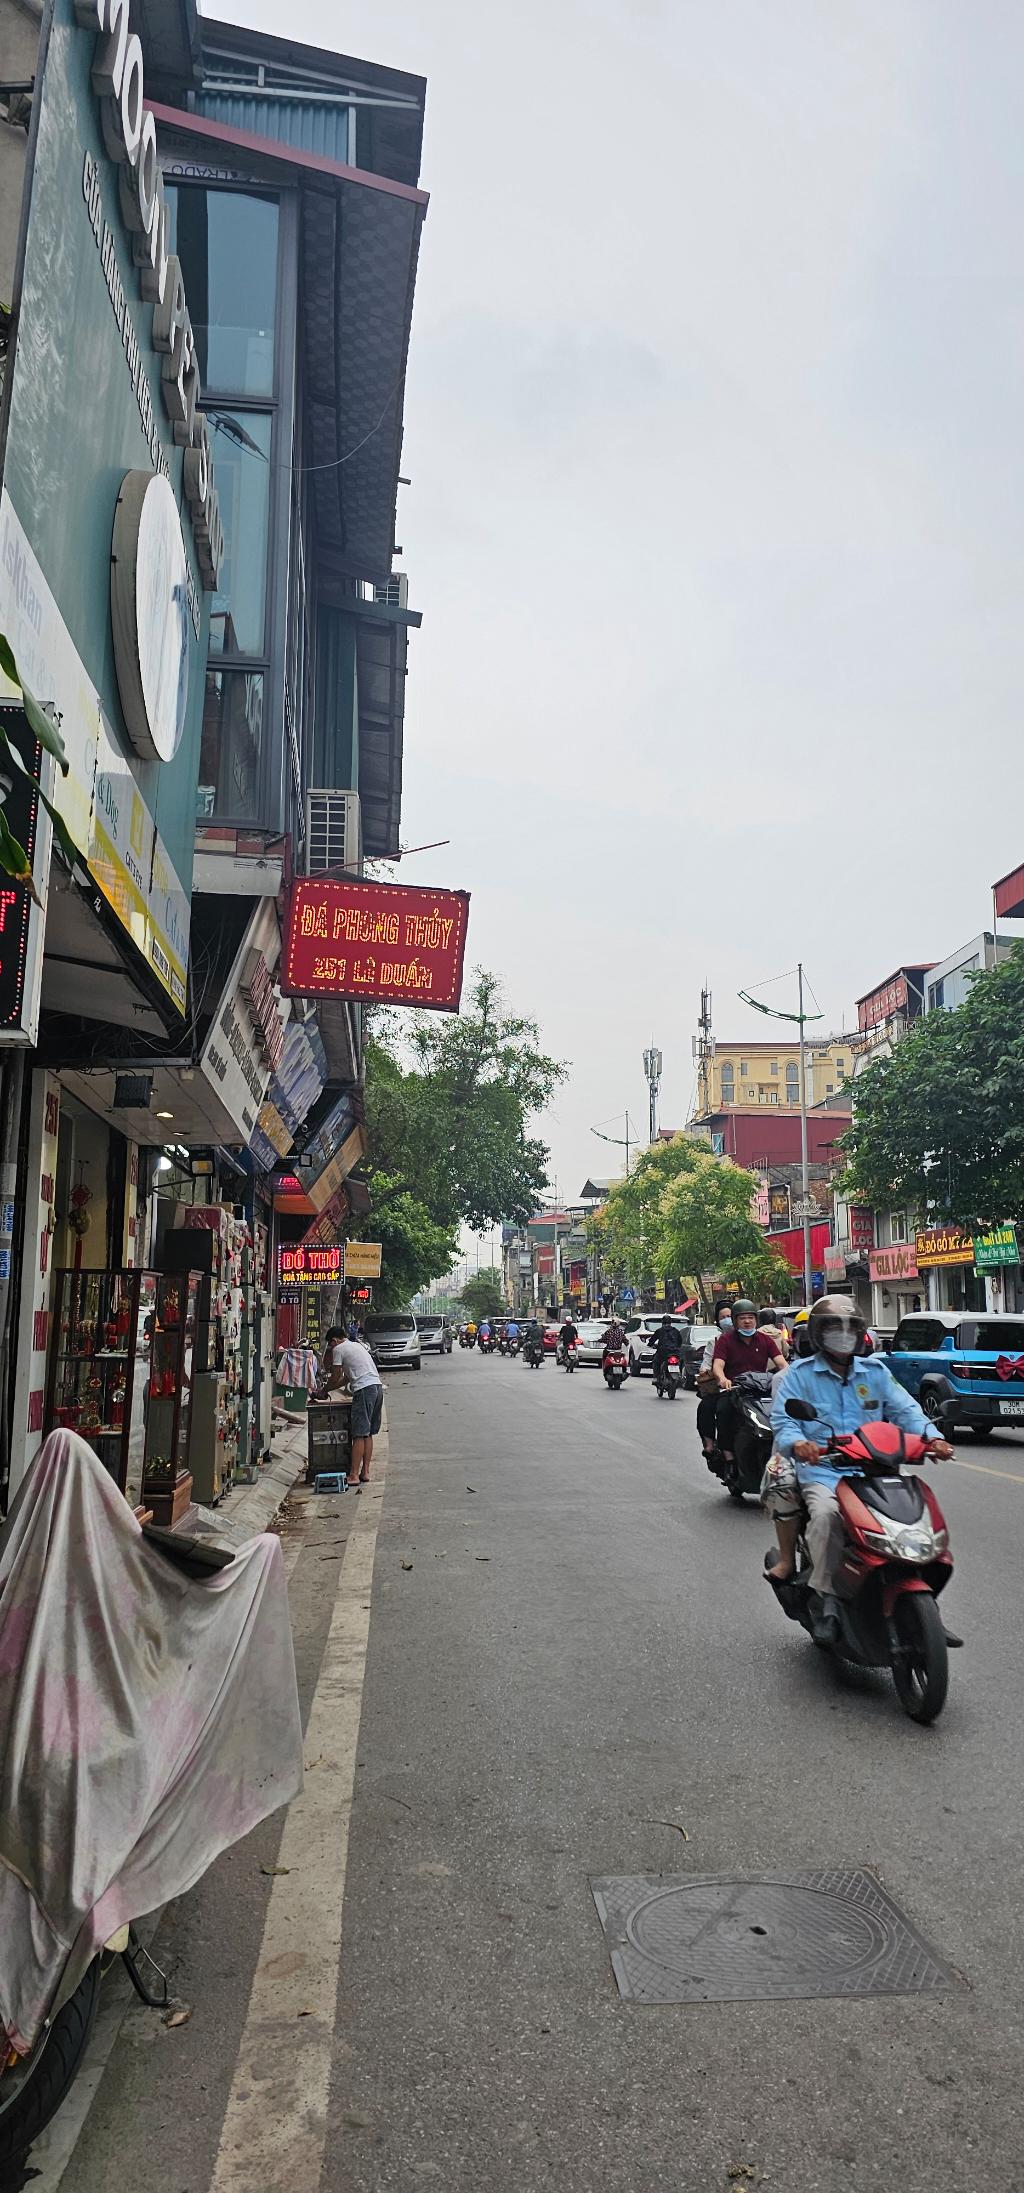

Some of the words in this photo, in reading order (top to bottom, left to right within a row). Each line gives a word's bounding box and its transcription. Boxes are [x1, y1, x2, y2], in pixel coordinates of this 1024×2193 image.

[101, 220, 125, 332] HÀNG
[122, 304, 140, 391] PHỤ
[105, 780, 119, 841] Dog
[301, 901, 328, 938] ĐÁ
[333, 908, 400, 944] PHONG
[405, 908, 453, 950] THỦY
[312, 957, 347, 981] 251
[853, 1220, 872, 1231] GIA
[853, 1233, 873, 1250] LỘC
[282, 1248, 304, 1270] ĐỒ
[309, 1248, 341, 1270] THỜ
[876, 1255, 891, 1276] GIA
[892, 1248, 910, 1278] LỘC
